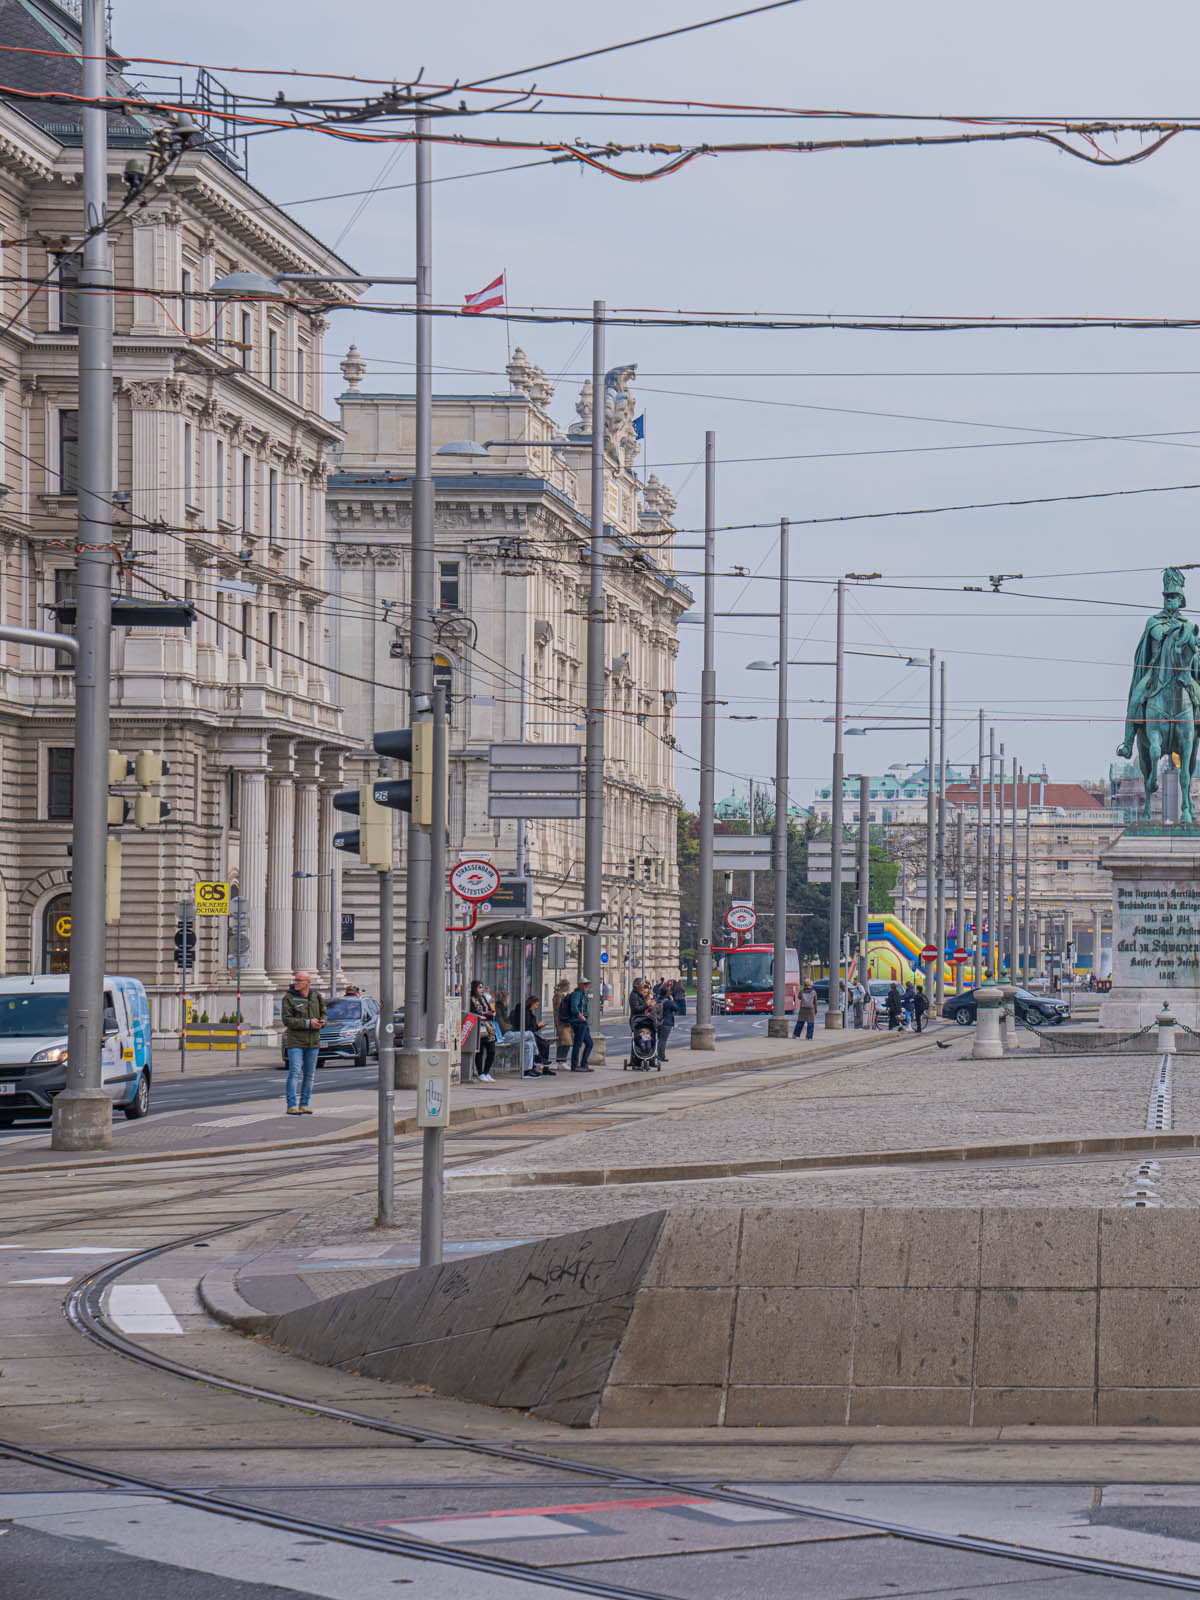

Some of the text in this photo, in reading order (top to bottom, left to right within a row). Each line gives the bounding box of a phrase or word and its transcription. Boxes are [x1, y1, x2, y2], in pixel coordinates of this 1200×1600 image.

[456, 864, 495, 878] STRASSENBAHN
[457, 884, 494, 896] HALTESTELLE
[1158, 902, 1166, 910] in
[1166, 901, 1178, 910] den
[1162, 914, 1172, 922] und
[1139, 944, 1149, 954] zu
[1130, 957, 1152, 968] Kaiser
